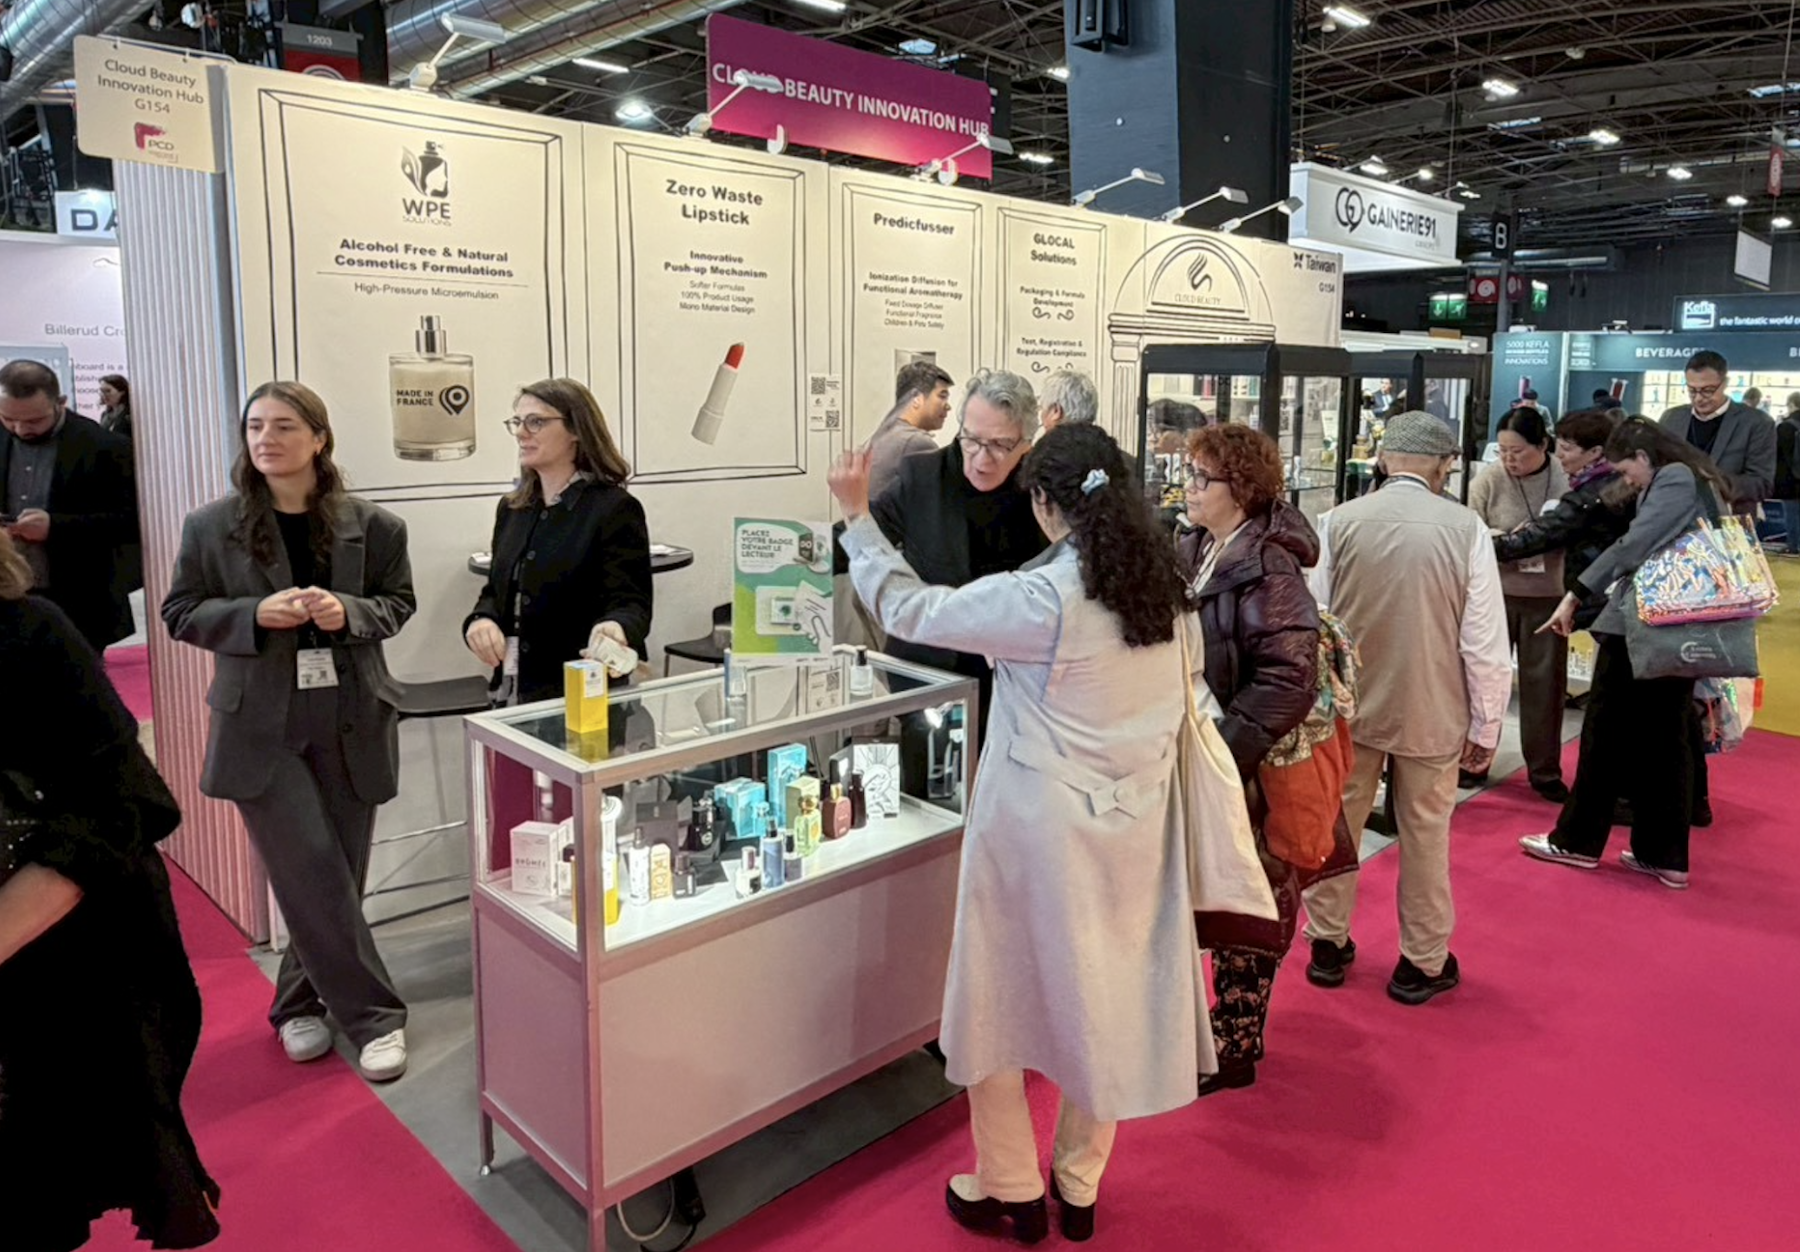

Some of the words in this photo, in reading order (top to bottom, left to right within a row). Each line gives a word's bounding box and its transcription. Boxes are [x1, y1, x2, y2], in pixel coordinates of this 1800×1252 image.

[307, 34, 332, 47] 1203
[104, 59, 146, 77] Cloud
[150, 67, 196, 88] Beauty
[98, 75, 172, 98] Innovation
[176, 90, 204, 104] Hub
[134, 98, 170, 114] G154
[785, 78, 854, 110] BEAUTY
[858, 94, 956, 132] INNOVATION
[959, 116, 989, 136] HUB
[148, 140, 174, 151] PCD
[666, 179, 706, 198] Zero
[712, 186, 763, 206] Waste
[402, 198, 450, 219] WPE
[682, 204, 750, 226] Lipstick
[873, 212, 954, 234] Predicfusser
[1368, 202, 1436, 238] GAINERIE91
[1033, 232, 1075, 250] GLOCAL
[1495, 222, 1508, 250] B
[340, 238, 399, 254] Alcohol
[404, 244, 437, 257] Free
[442, 247, 452, 258] &
[458, 248, 508, 262] Natural
[690, 250, 744, 264] Innovative
[1031, 249, 1077, 266] Solutions
[334, 254, 417, 272] Cosmetics
[422, 261, 514, 278] Formulations
[664, 262, 706, 276] Push-up
[710, 266, 768, 279] Mechanism
[1306, 254, 1336, 274] Taiwan
[354, 282, 428, 296] High-Pressure
[431, 287, 500, 300] Microemulsion
[712, 282, 745, 292] Formulas
[864, 283, 907, 295] Functional
[1319, 282, 1335, 293] G154
[681, 292, 700, 300] 100%
[703, 292, 730, 302] Product
[732, 295, 754, 304] Usage
[702, 302, 730, 312] Material
[731, 304, 756, 315] Design
[1720, 317, 1733, 326] the
[1734, 316, 1768, 326] fantastic
[1769, 314, 1794, 325] world
[45, 324, 100, 336] Billerud
[1506, 340, 1524, 348] 5000
[1636, 347, 1706, 358] BEVERAG
[396, 390, 422, 398] MADE
[424, 390, 434, 398] IN
[397, 398, 434, 406] FRANCE
